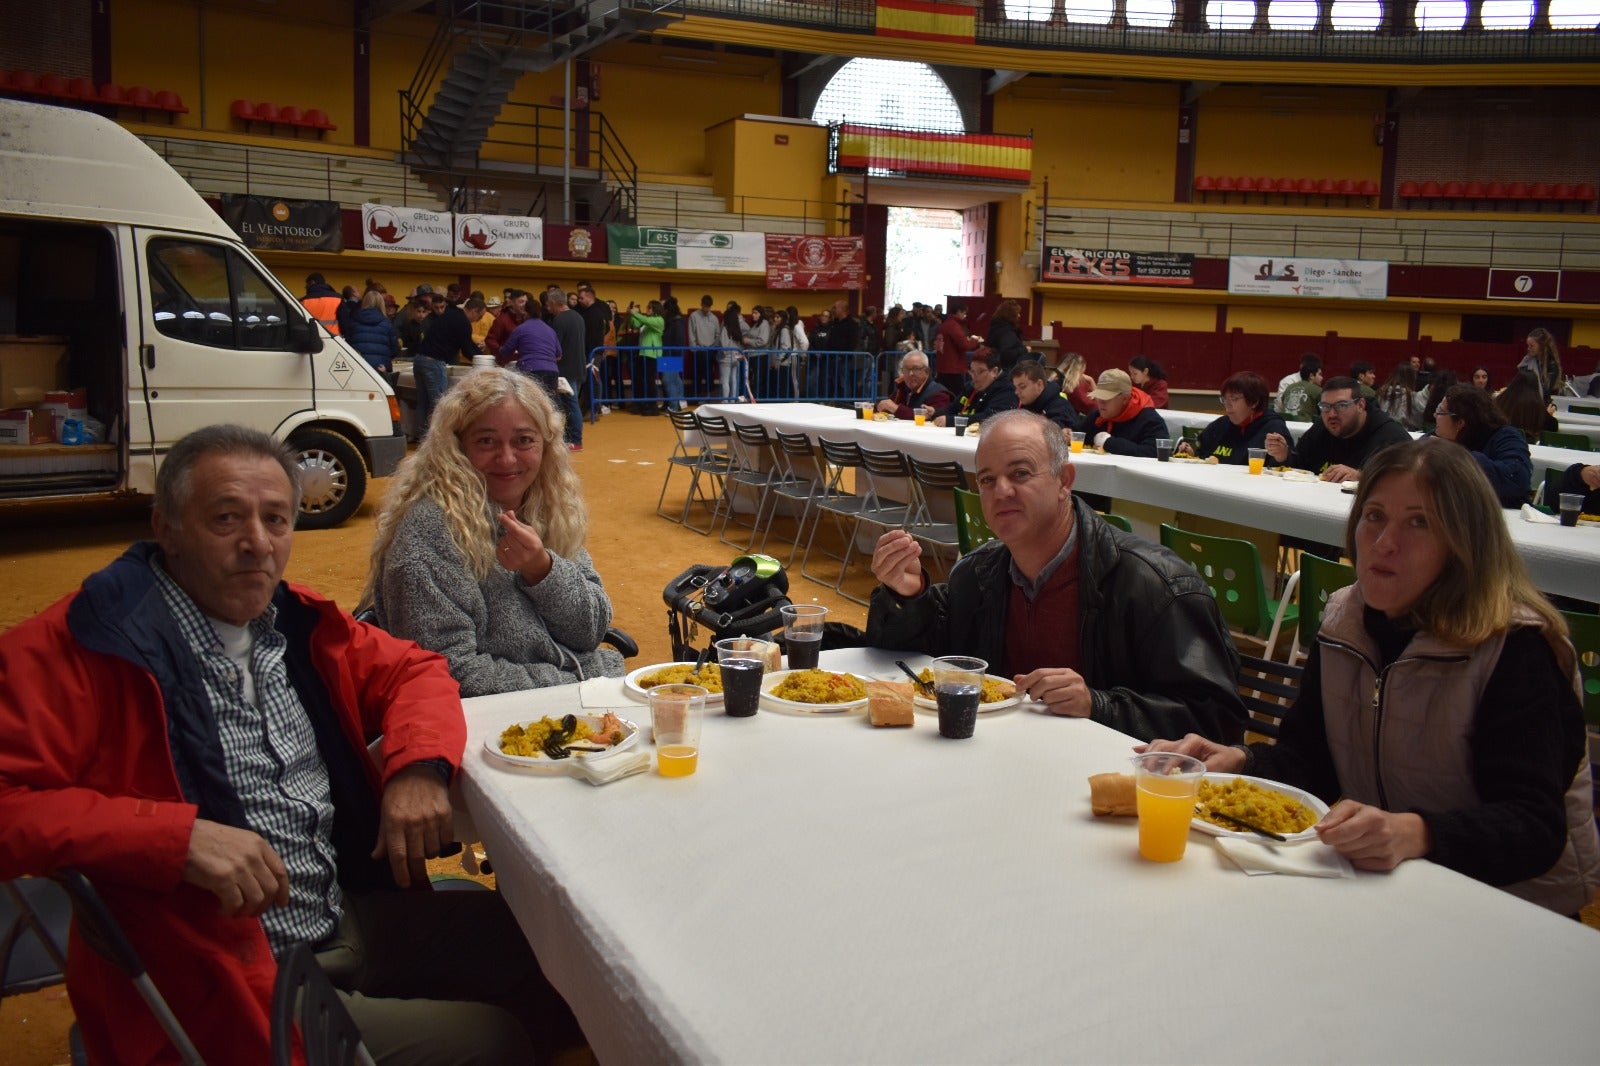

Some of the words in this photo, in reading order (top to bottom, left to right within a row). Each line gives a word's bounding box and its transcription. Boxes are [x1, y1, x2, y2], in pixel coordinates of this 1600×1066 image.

[413, 212, 440, 221] GRUPO
[241, 221, 255, 233] EL
[258, 223, 322, 237] VENTORRO
[400, 220, 451, 235] SALMANTINA
[503, 219, 530, 228] GRUPO
[490, 228, 541, 241] SALMANTINA
[656, 233, 676, 243] est
[365, 243, 415, 252] CONSTRUCCIONES
[1050, 256, 1130, 276] REYES
[1304, 267, 1326, 278] Diego
[1519, 277, 1529, 291] 7
[335, 361, 347, 369] SA
